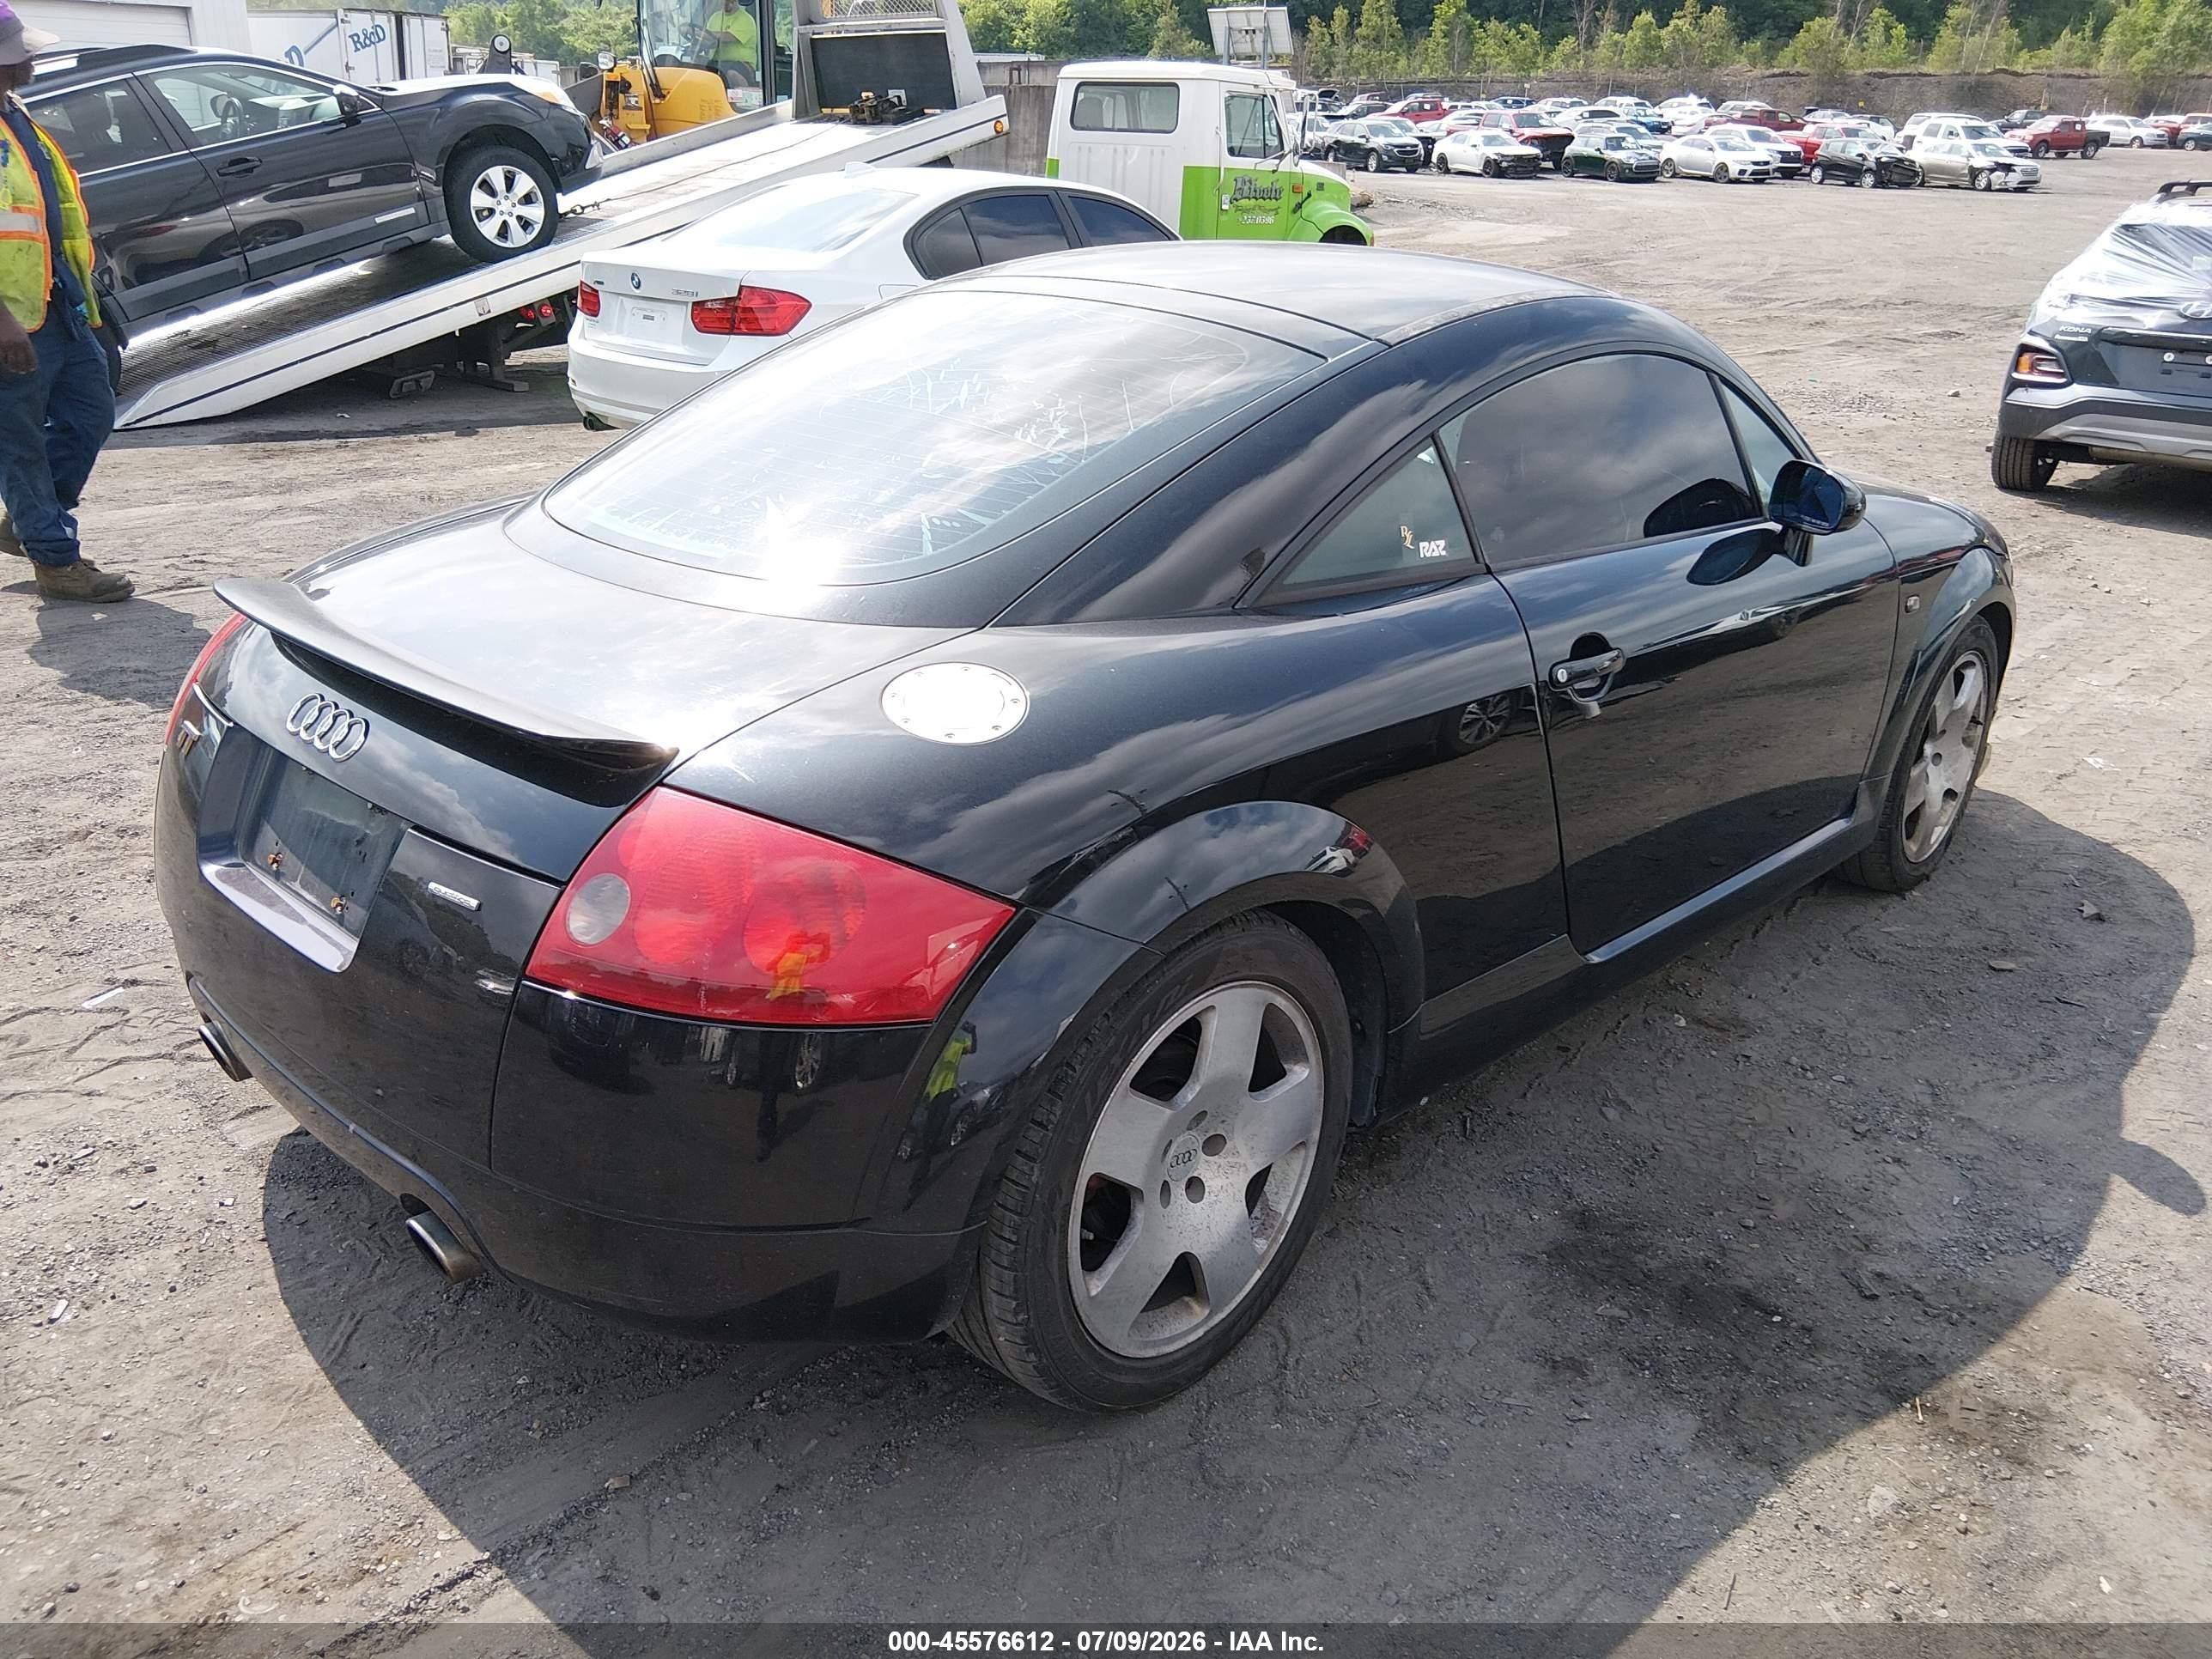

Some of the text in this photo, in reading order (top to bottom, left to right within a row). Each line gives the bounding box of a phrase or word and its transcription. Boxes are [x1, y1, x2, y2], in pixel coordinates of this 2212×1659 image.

[348, 24, 386, 53] R&D
[2059, 325, 2092, 334] KONA
[1419, 539, 1447, 558] RAZ
